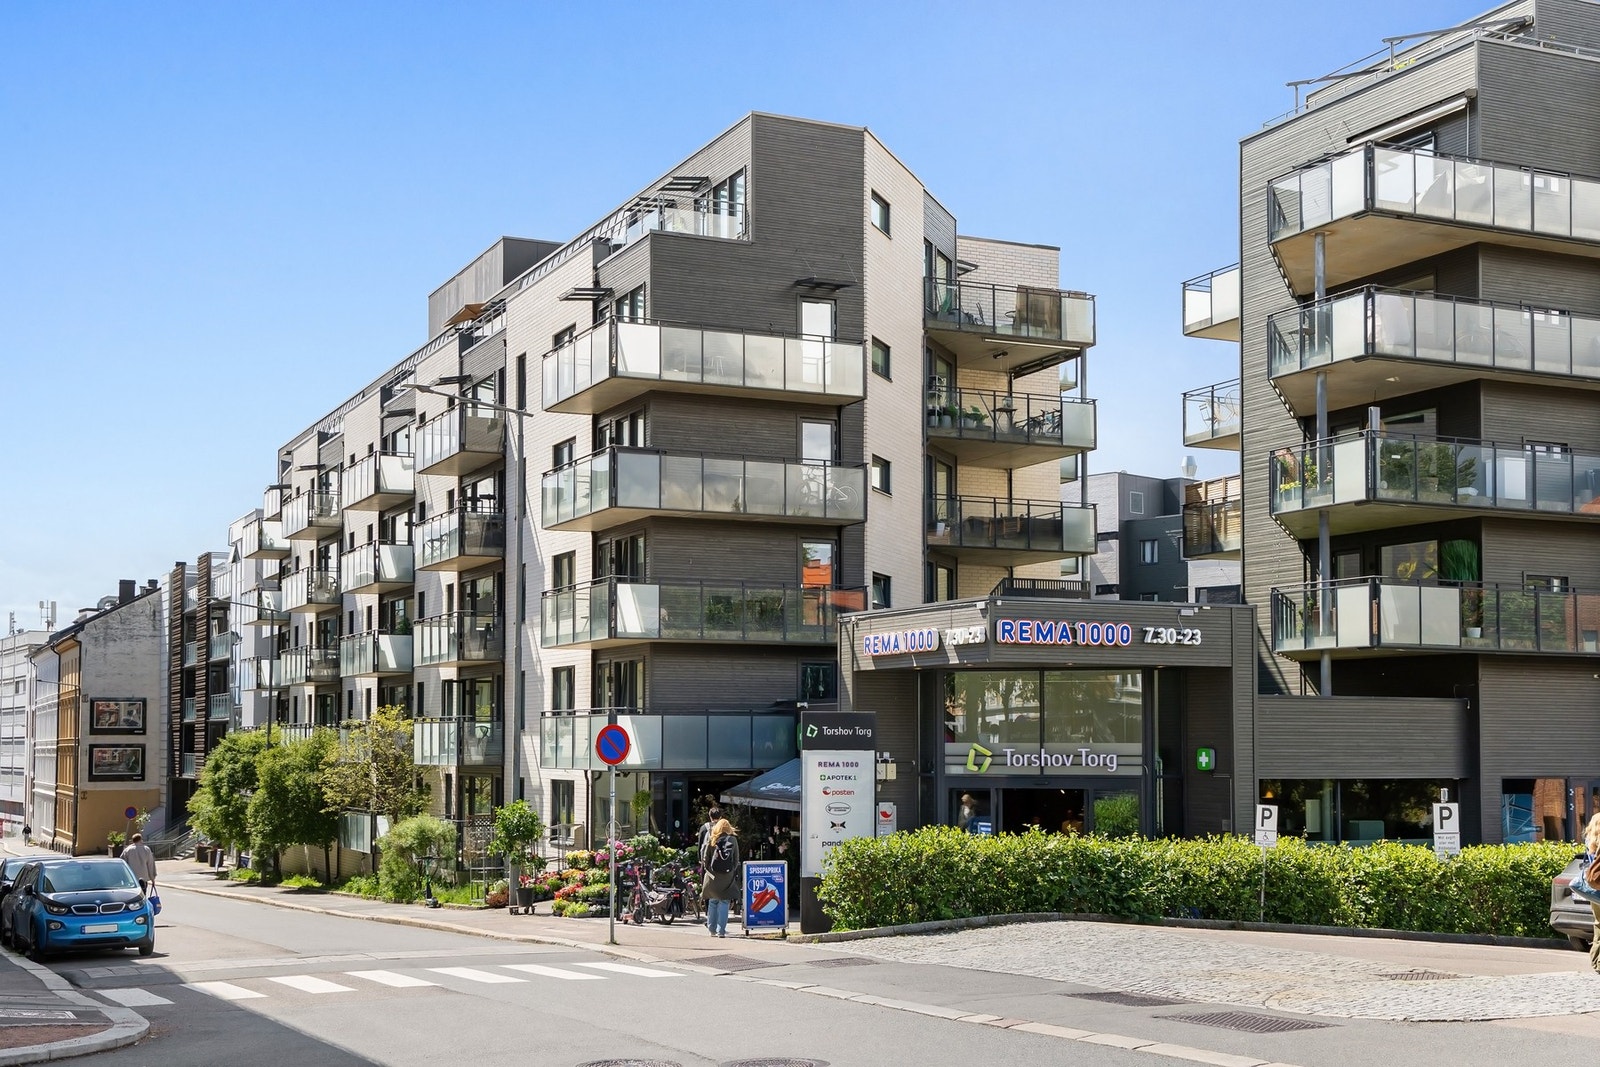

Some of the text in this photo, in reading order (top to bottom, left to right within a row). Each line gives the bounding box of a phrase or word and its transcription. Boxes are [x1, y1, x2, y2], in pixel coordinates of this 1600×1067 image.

[863, 629, 935, 655] REMA 1000
[998, 619, 1132, 646] REMA 1000
[1143, 626, 1202, 646] 7.30-23
[822, 726, 872, 738] Torshov Torg
[1002, 748, 1118, 772] Torshov Torg
[1261, 807, 1273, 828] P
[1439, 806, 1453, 830] P
[749, 866, 781, 874] SPISSPAPRIKA
